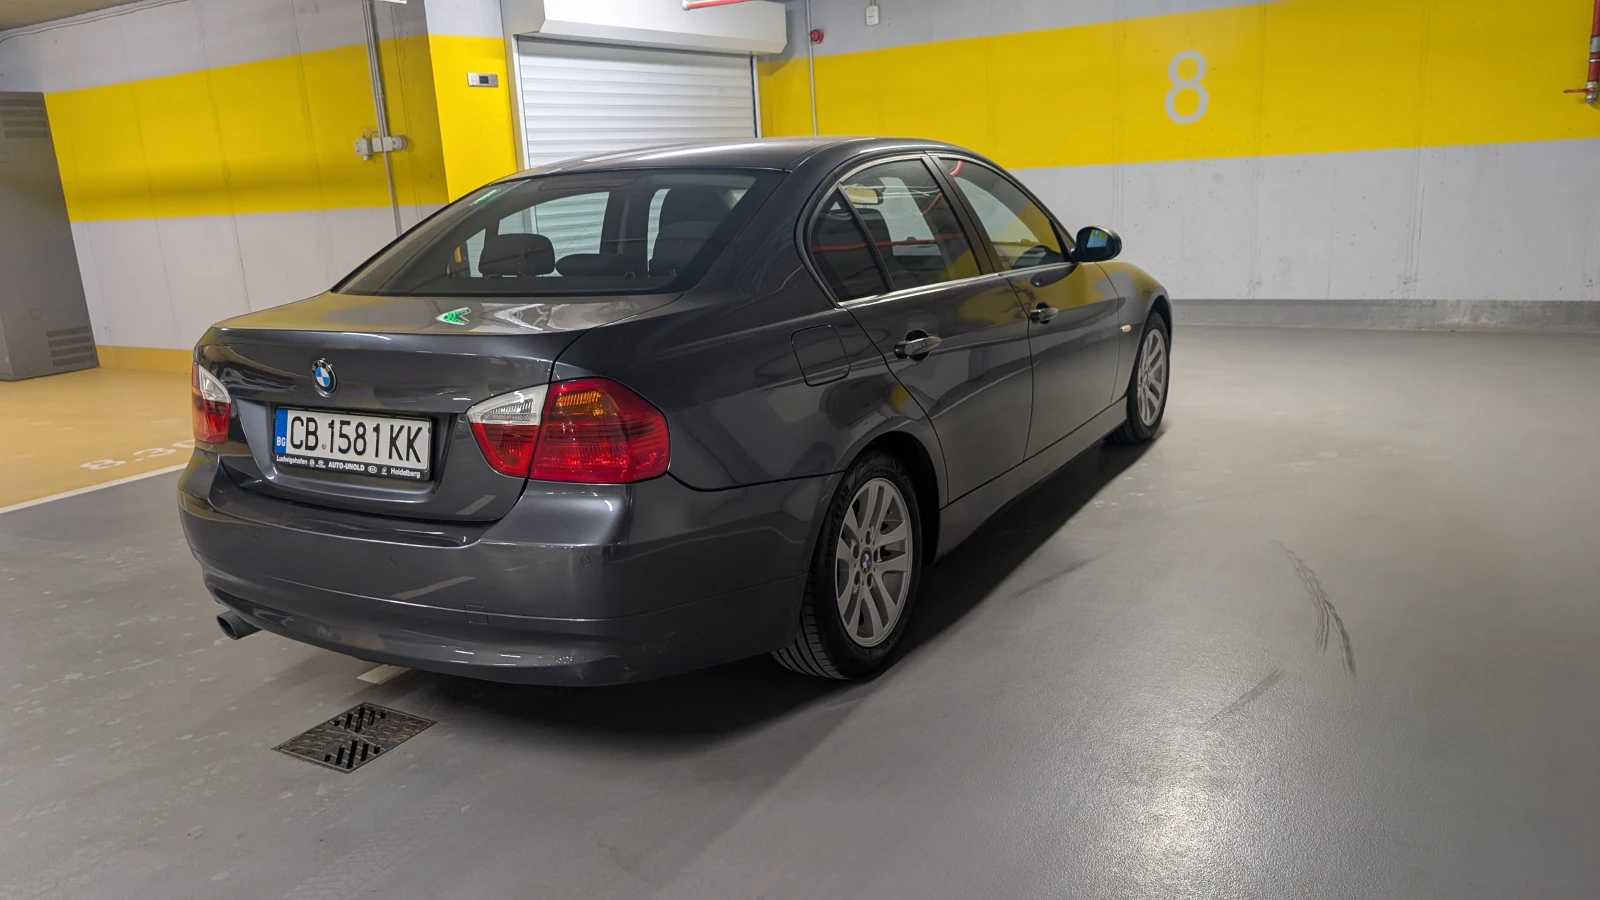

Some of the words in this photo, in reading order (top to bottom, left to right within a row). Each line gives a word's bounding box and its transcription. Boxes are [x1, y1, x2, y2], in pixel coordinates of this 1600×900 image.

[1165, 49, 1209, 124] 8
[276, 436, 286, 447] BG
[290, 416, 319, 451] CB
[328, 419, 380, 458] 1581
[388, 424, 423, 463] KK
[276, 455, 308, 465] Ludwigshafen
[328, 461, 365, 471] AUTO-UNOLD
[390, 467, 421, 479] Heidelberg
